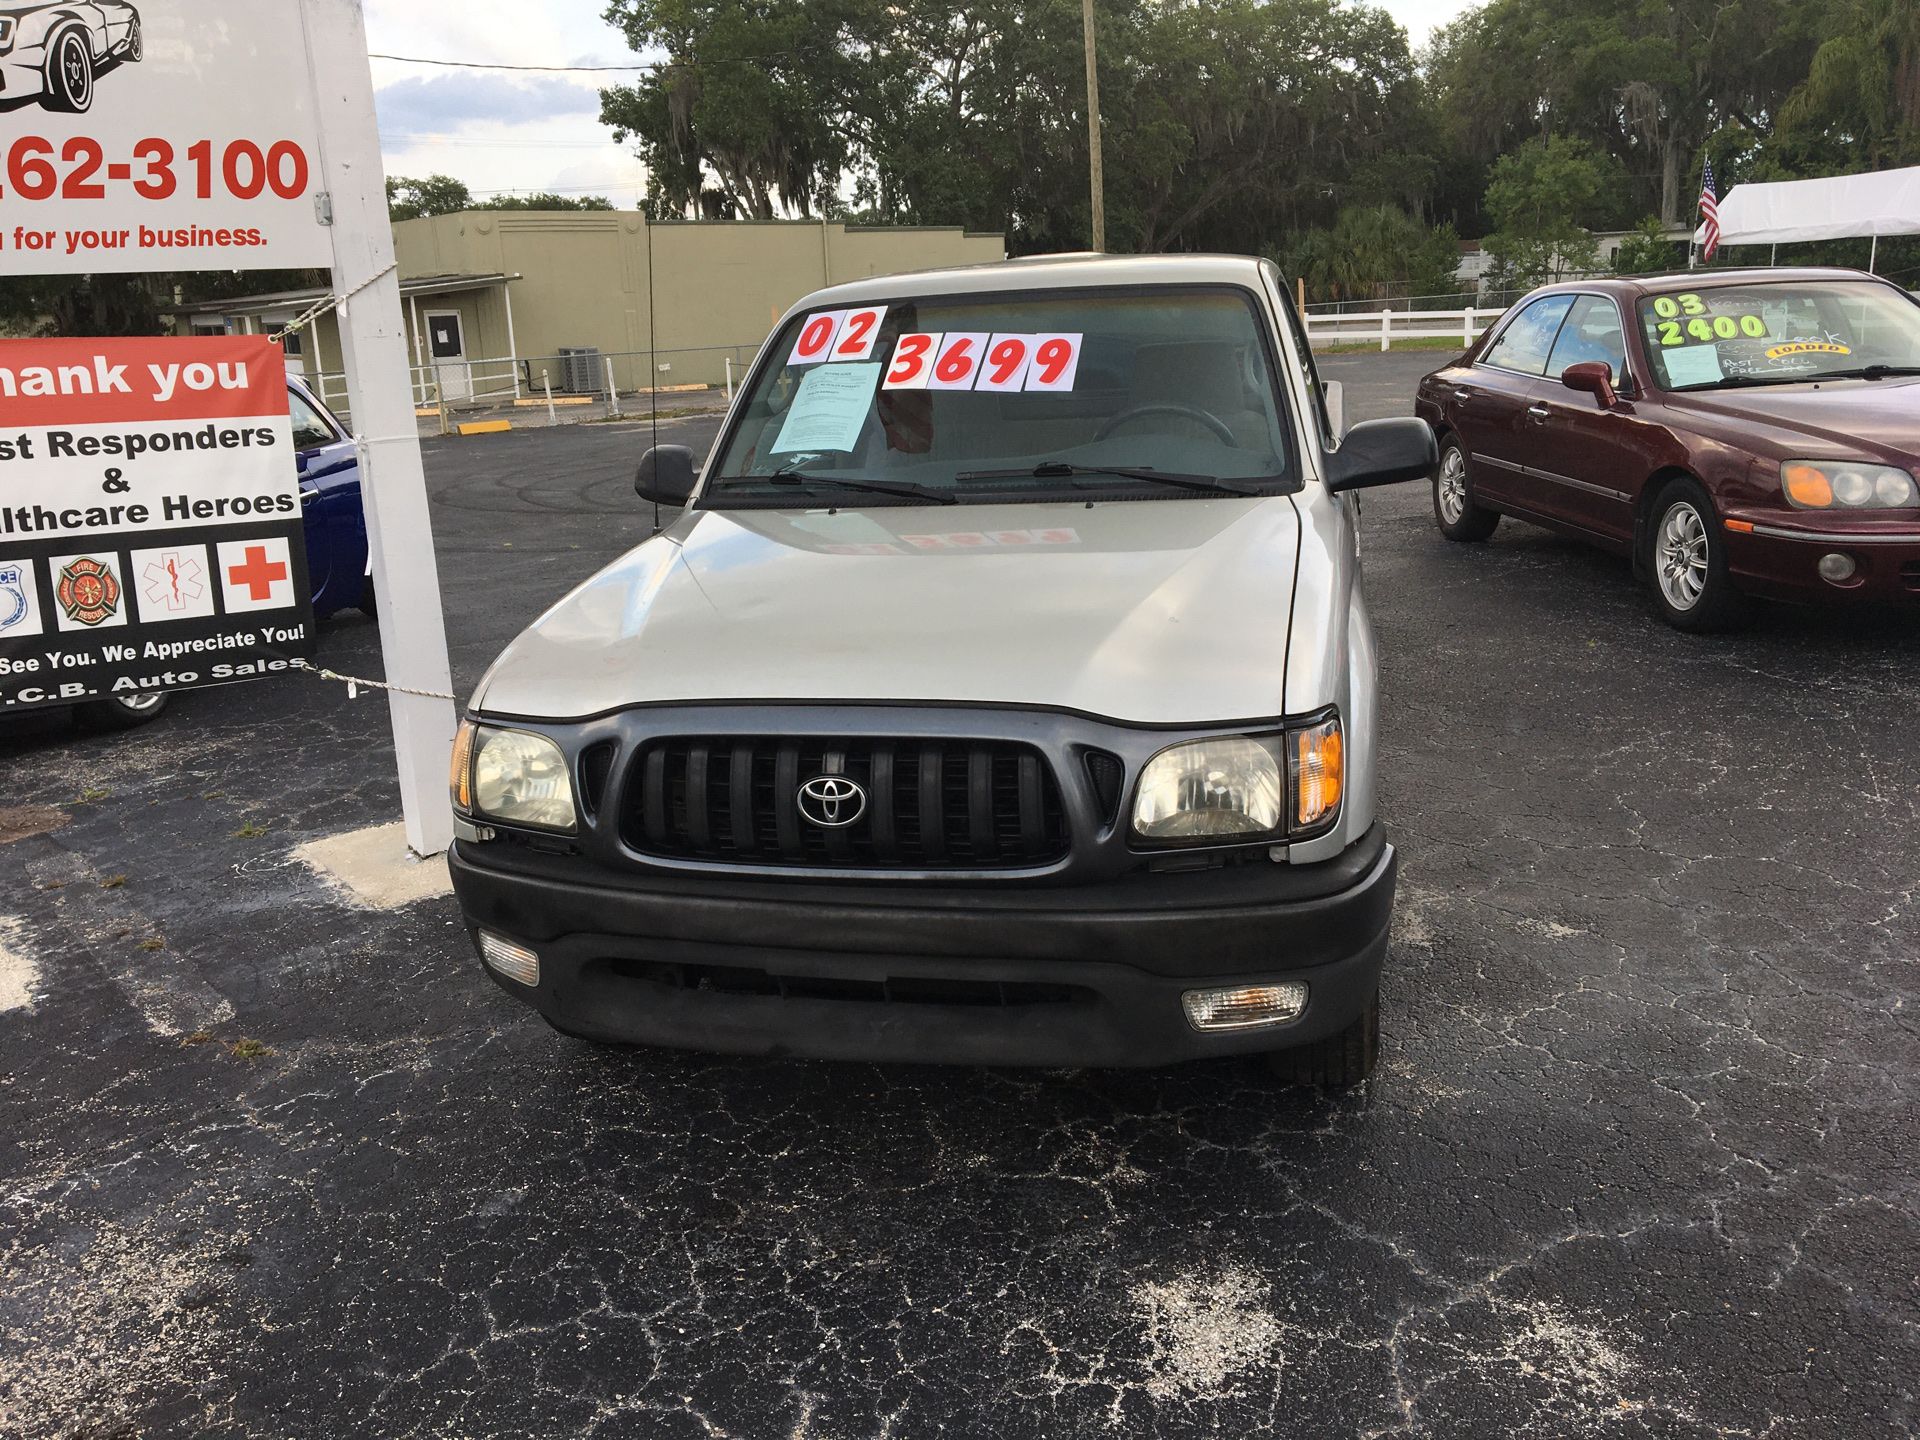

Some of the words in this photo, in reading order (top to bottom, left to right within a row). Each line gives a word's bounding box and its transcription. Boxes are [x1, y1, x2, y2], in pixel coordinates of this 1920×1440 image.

[0, 135, 309, 200] 62-3100
[13, 226, 56, 250] for
[66, 228, 130, 254] your
[138, 225, 268, 248] business.
[1654, 294, 1706, 318] 03
[798, 311, 878, 357] 02
[1657, 315, 1767, 346] 2400
[887, 334, 1073, 385] 3699
[1774, 344, 1840, 355] LOADED
[147, 360, 249, 402] you
[46, 424, 276, 460] Responders
[102, 467, 131, 494] &
[0, 499, 149, 534] lthcare
[162, 491, 295, 522] Heroes
[76, 563, 94, 573] FIRE
[79, 608, 105, 620] RESCUE
[0, 657, 40, 675] See
[45, 651, 97, 669] You.
[102, 645, 136, 663] We
[143, 631, 256, 661] Appreciate
[261, 623, 306, 644] You!
[0, 682, 98, 705] .C.B.
[111, 668, 199, 692] Auto
[211, 656, 306, 680] Sales
